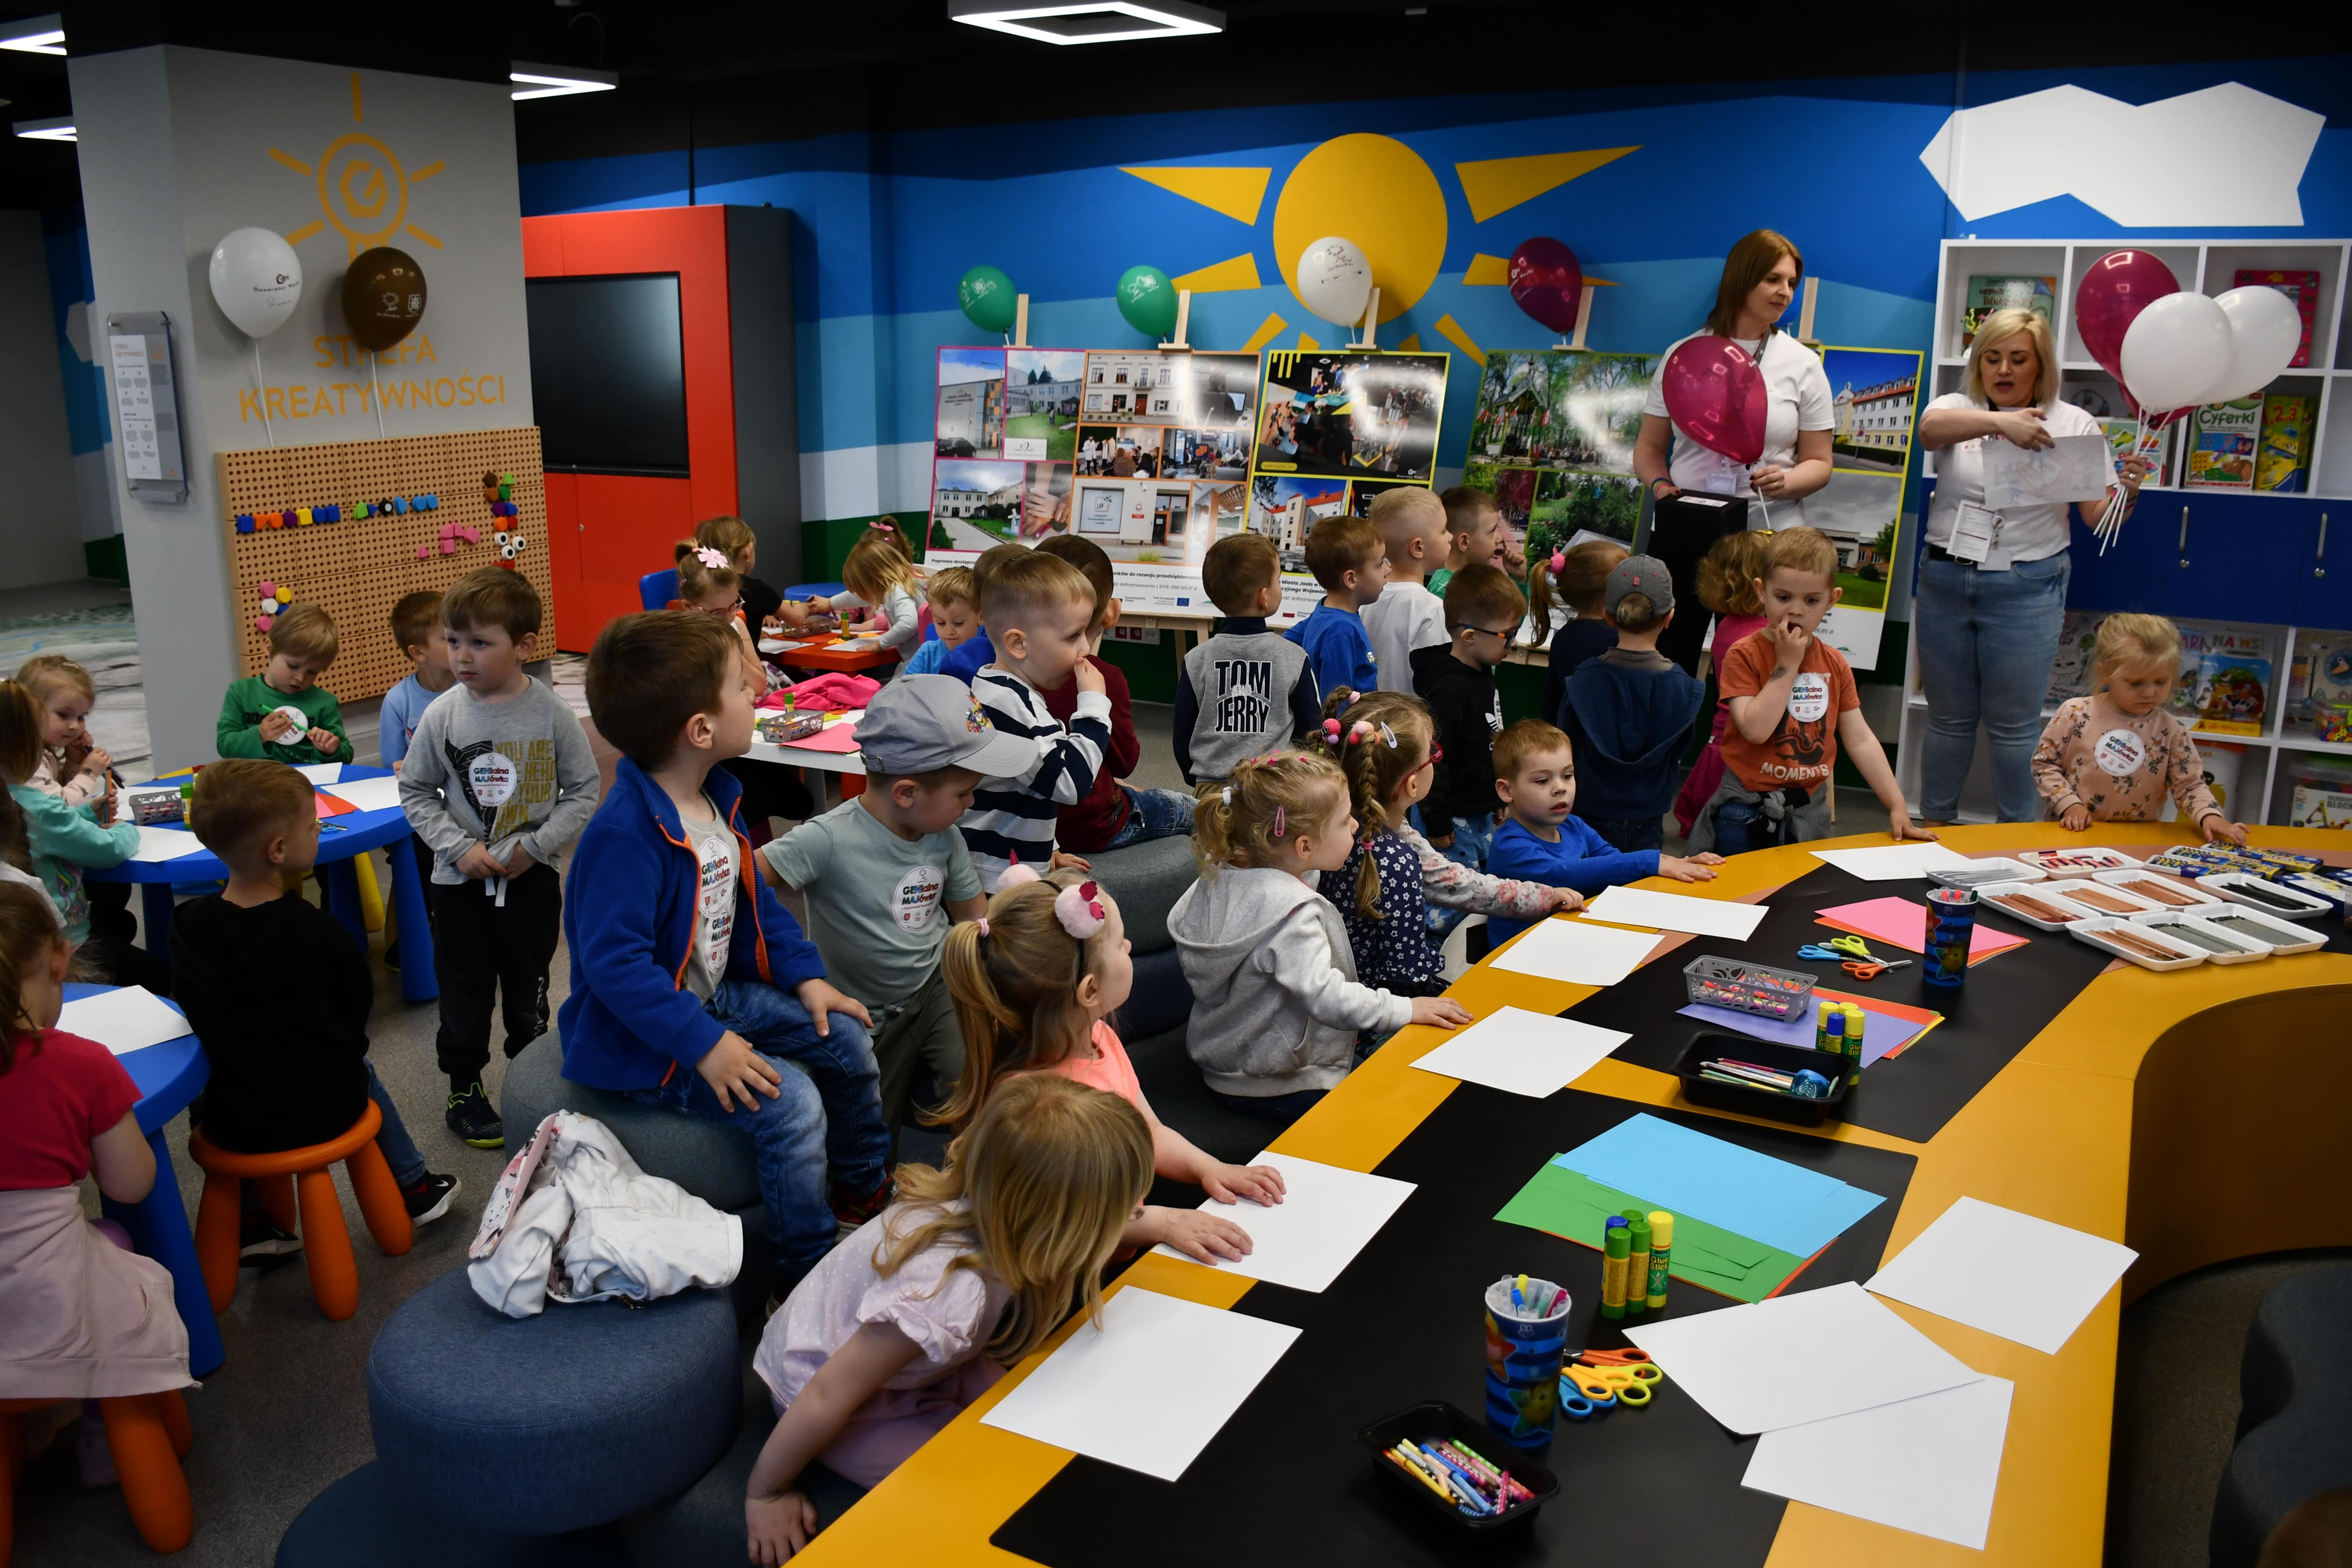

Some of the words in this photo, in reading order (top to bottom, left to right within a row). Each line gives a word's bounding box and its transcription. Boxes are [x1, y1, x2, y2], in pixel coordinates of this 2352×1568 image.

[239, 368, 505, 422] KREATYWNOŚCI
[2200, 410, 2256, 425] Cyferki
[1214, 659, 1272, 703] TOM
[1214, 695, 1271, 734] JERRY
[494, 740, 523, 762] YOU
[528, 739, 553, 760] ARE
[1760, 762, 1829, 781] MOMENTS
[518, 781, 553, 803] YOUR
[702, 856, 729, 875] GENIalna
[702, 868, 730, 888] MAJówka
[901, 893, 936, 905] MAJówka
[903, 883, 939, 895] GENIalna
